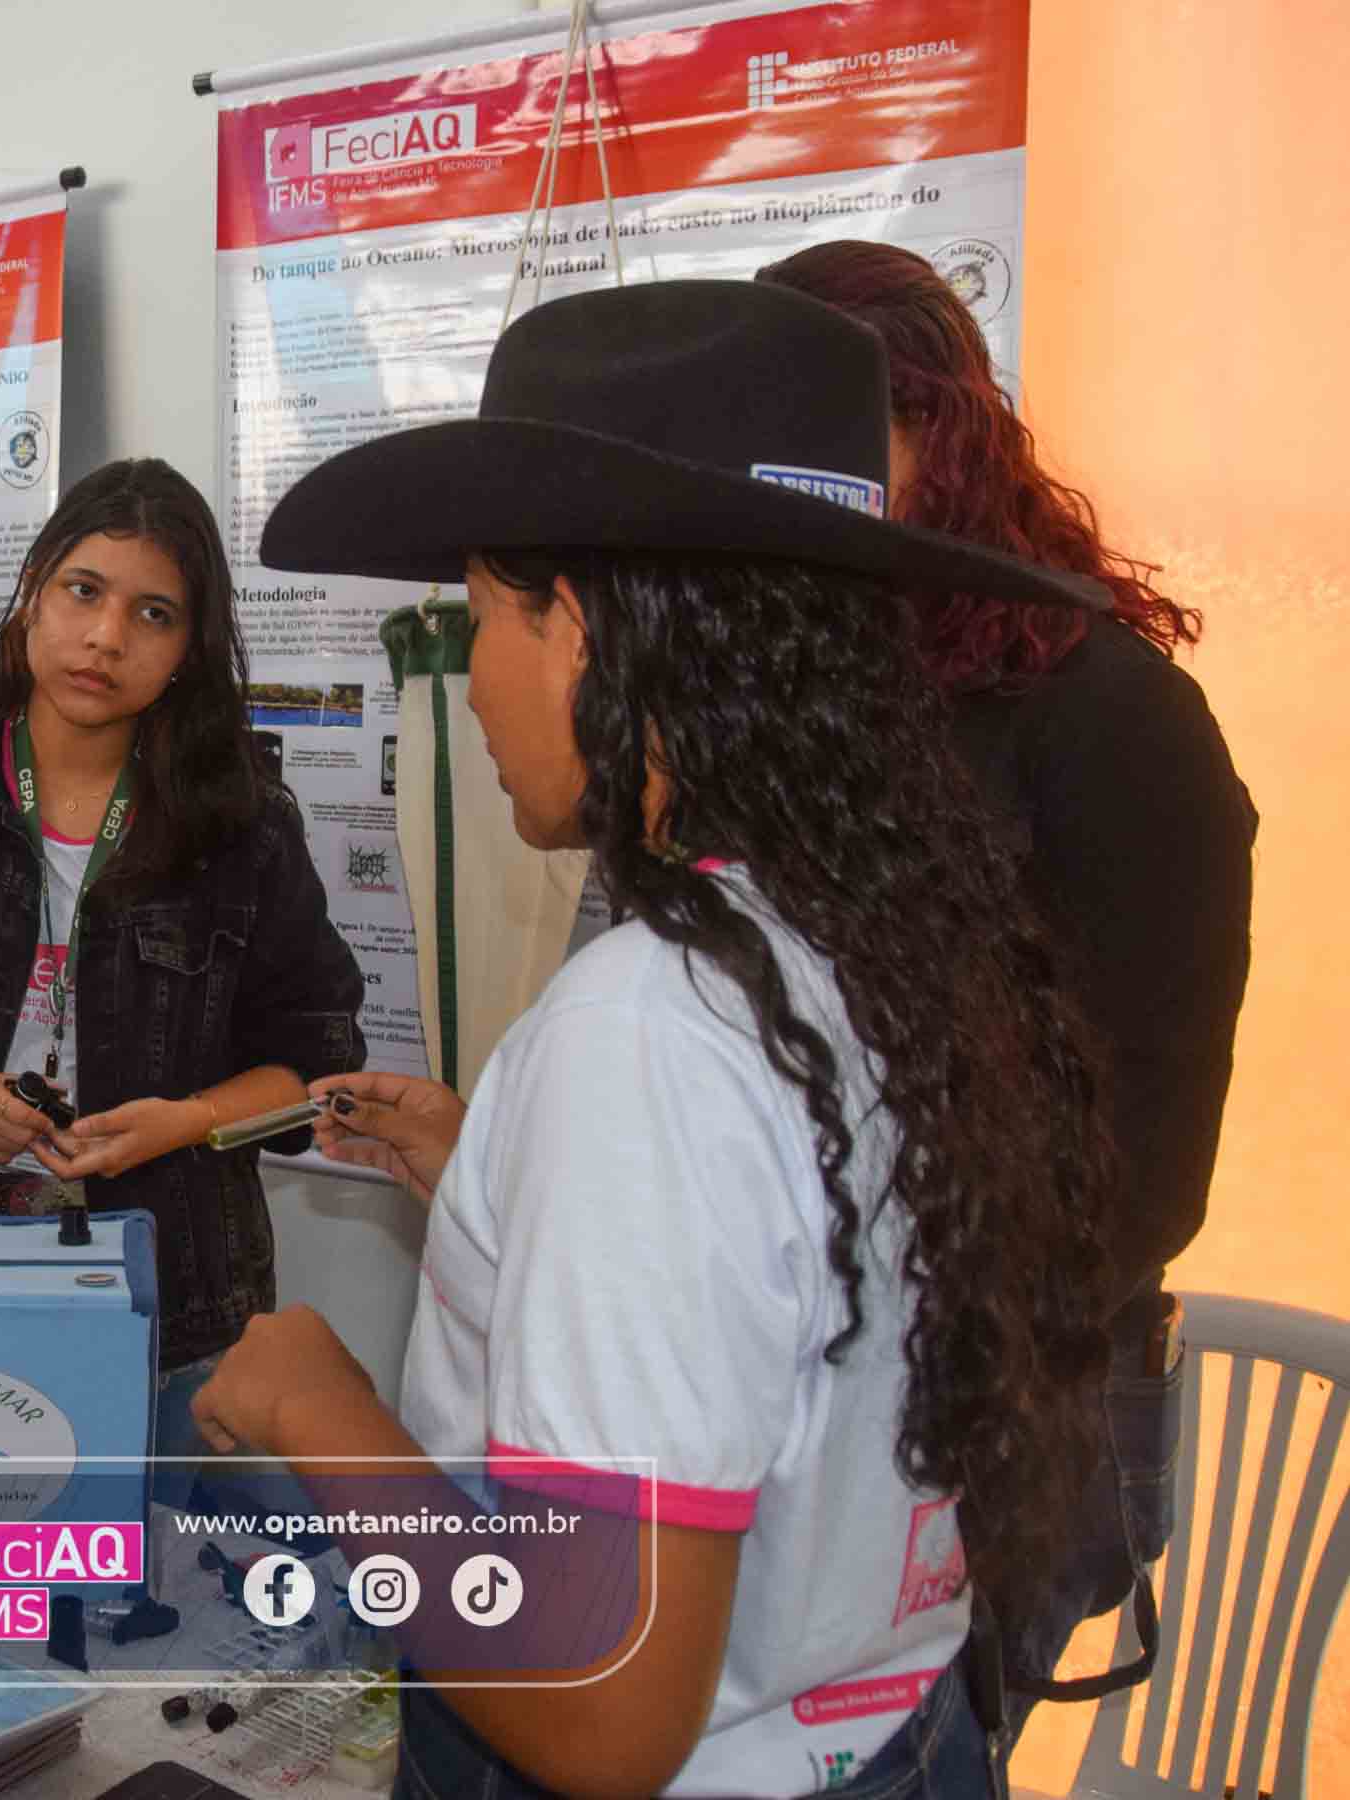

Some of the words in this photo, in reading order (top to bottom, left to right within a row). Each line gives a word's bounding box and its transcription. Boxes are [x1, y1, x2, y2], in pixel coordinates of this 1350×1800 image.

[886, 39, 960, 64] FEDERAL
[325, 112, 461, 168] FeciAQ
[267, 178, 327, 214] IFMS
[252, 264, 276, 283] Do
[280, 256, 338, 281] tanque
[340, 257, 362, 272] ao
[576, 224, 600, 243] de
[730, 207, 757, 225] no
[912, 184, 940, 206] do
[233, 586, 327, 603] Metodologia
[18, 767, 35, 813] CEPA
[102, 798, 129, 841] CEPA
